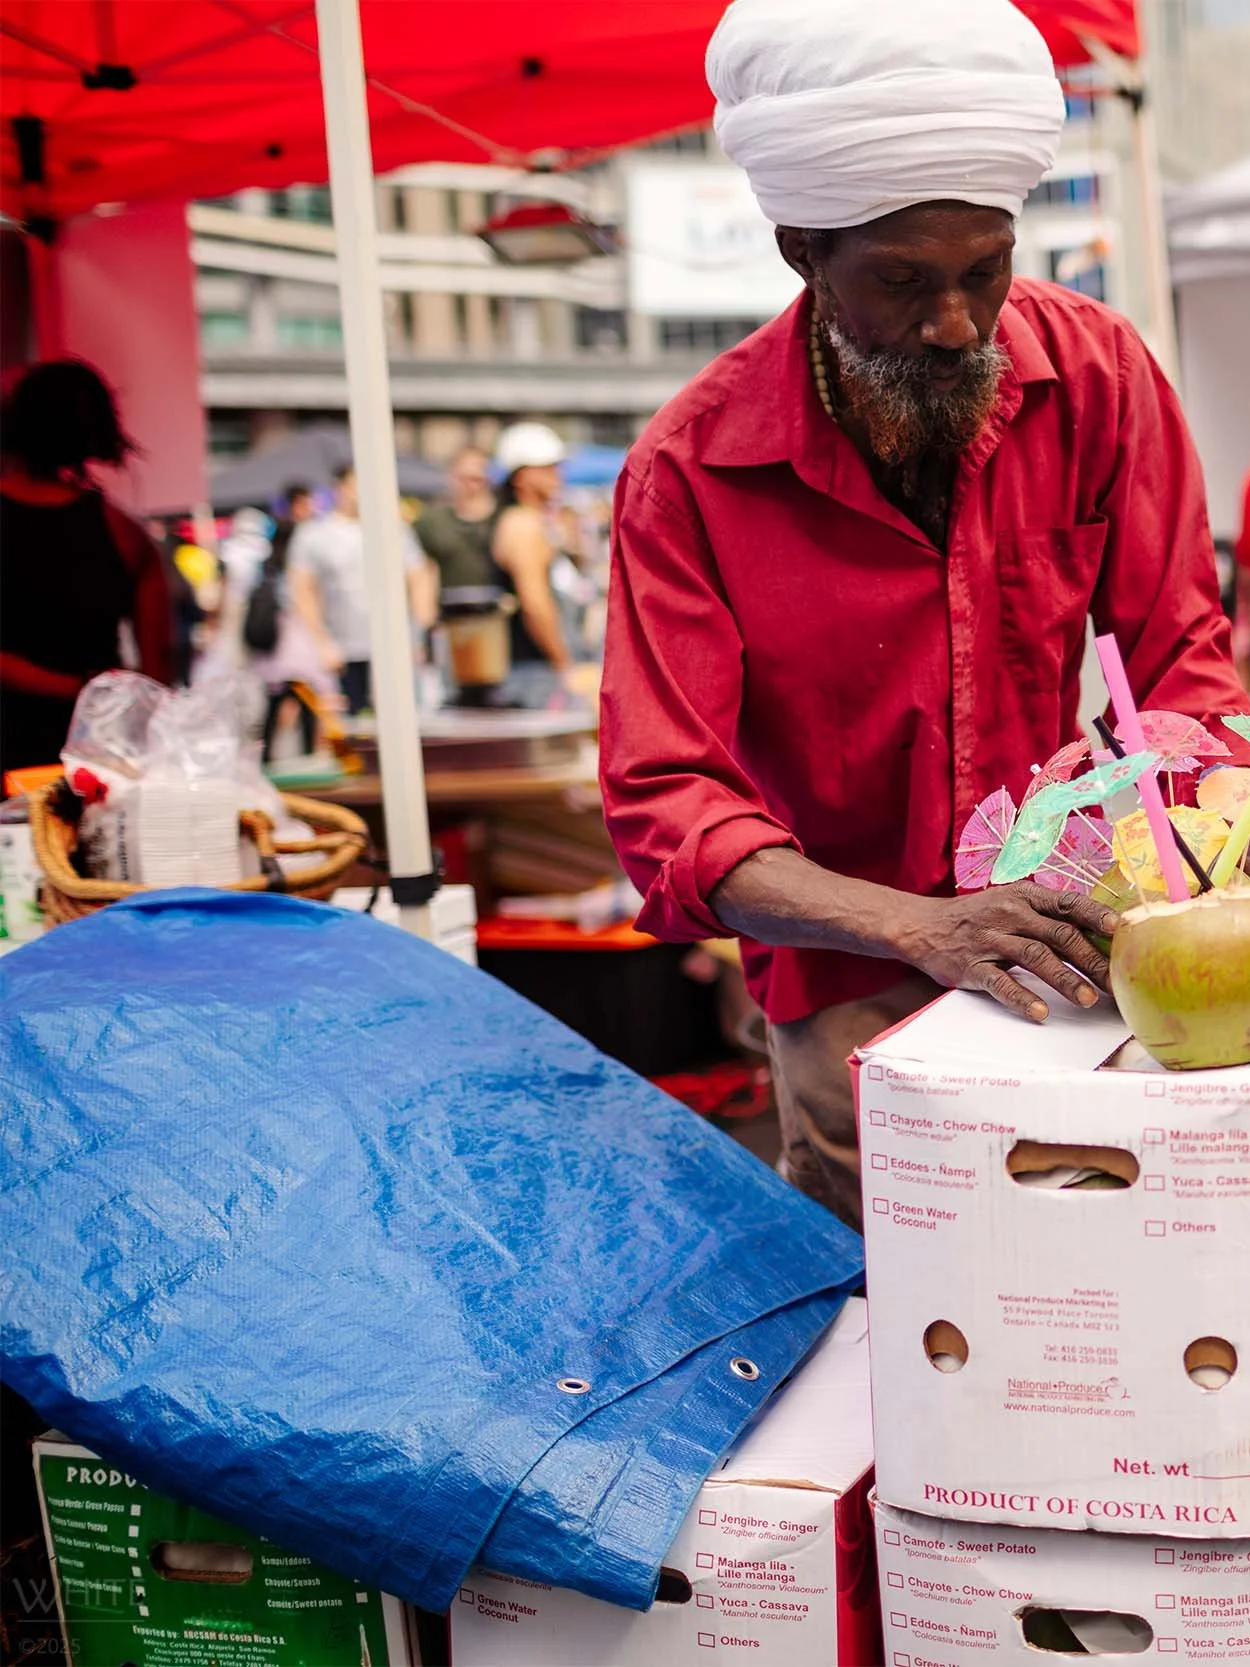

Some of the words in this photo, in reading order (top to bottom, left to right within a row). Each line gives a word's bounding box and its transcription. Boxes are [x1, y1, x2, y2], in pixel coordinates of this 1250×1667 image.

[886, 1068, 928, 1083] Camote
[939, 1075, 977, 1085] Sweet
[980, 1077, 1021, 1088] Potato
[1170, 1083, 1228, 1095] Jengibre
[889, 1113, 933, 1129] Chayote
[943, 1120, 977, 1133] Chow
[981, 1122, 1016, 1134] Chow
[1169, 1130, 1224, 1142] Malanga
[1170, 1143, 1197, 1153] Lille
[890, 1158, 929, 1173] Eddoes
[1172, 1176, 1204, 1187] Yuca
[893, 1201, 923, 1216] Green
[926, 1207, 957, 1221] Water
[893, 1215, 936, 1231] Coconut
[1172, 1221, 1216, 1232] Others
[998, 1294, 1030, 1303] National
[1032, 1296, 1063, 1305] Produce
[1003, 1402, 1136, 1417] www.nationalproduce.com
[1113, 1457, 1155, 1475] Net.
[1164, 1461, 1189, 1477] wt
[66, 1466, 148, 1489] PRODU
[924, 1484, 1039, 1512] PRODUCT
[1046, 1497, 1079, 1515] OF
[1086, 1500, 1166, 1520] COSTA
[1175, 1505, 1238, 1524] RICA
[721, 1513, 768, 1528] Jengibre
[779, 1520, 819, 1534] Ginger
[903, 1534, 946, 1550] Camote
[957, 1540, 993, 1553] Sweet
[997, 1542, 1036, 1554] Potato
[718, 1556, 766, 1571] Malanga
[1179, 1550, 1234, 1564] Jengibre
[717, 1569, 741, 1579] Lille
[745, 1570, 795, 1583] malanga
[908, 1576, 952, 1593] Chayote
[962, 1585, 996, 1598] Chow
[999, 1588, 1033, 1602] Chow
[478, 1594, 506, 1609] Green
[508, 1601, 537, 1616] Water
[719, 1597, 748, 1608] Yuca
[759, 1600, 809, 1612] Cassava
[1181, 1596, 1233, 1608] Malanga
[478, 1605, 519, 1623] Coconut
[1181, 1607, 1207, 1617] Lille
[910, 1617, 950, 1633] Eddoes
[960, 1624, 997, 1640] Ñampi
[229, 1633, 252, 1643] Costa
[253, 1634, 271, 1644] Rica
[721, 1636, 760, 1648] Others
[1184, 1638, 1214, 1648] Yuca
[914, 1657, 945, 1667] Green
